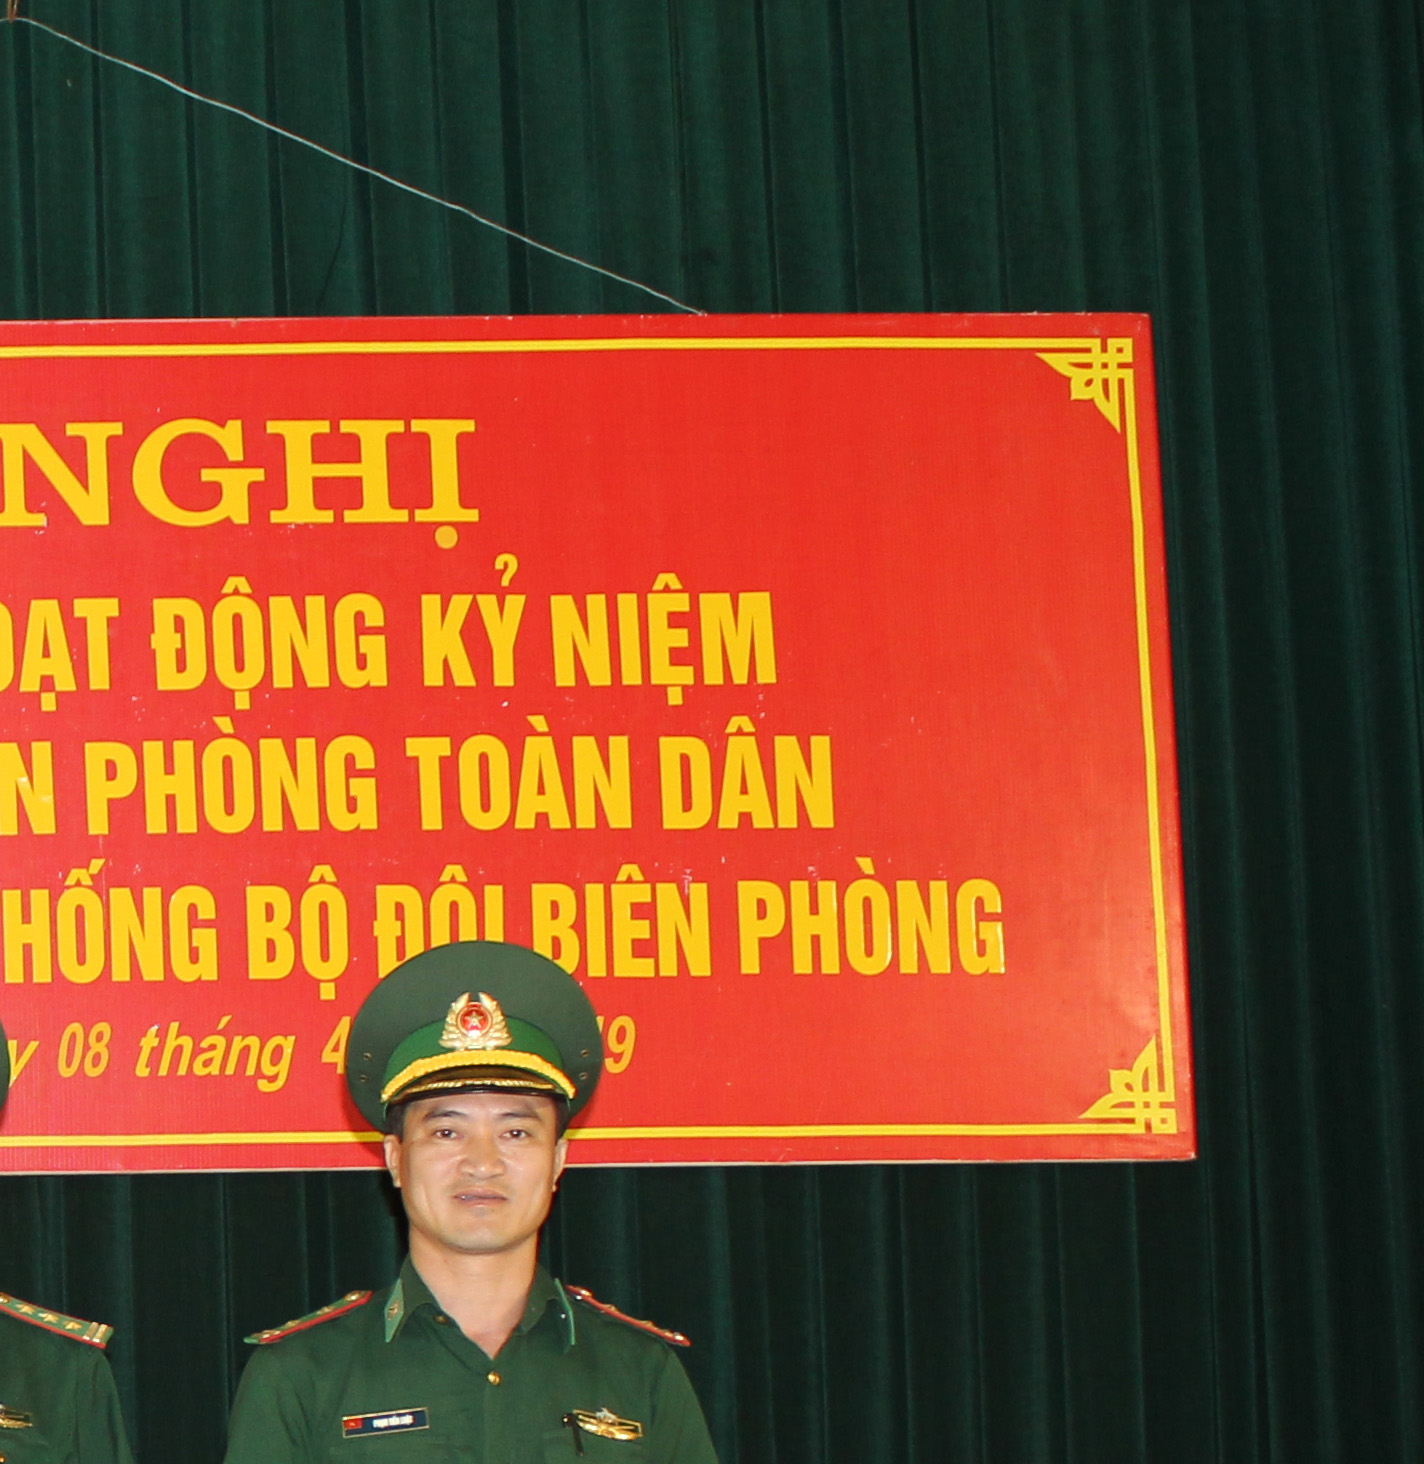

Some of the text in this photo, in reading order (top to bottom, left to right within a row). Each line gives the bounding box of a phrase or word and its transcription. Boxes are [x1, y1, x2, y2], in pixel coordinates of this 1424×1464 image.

[149, 575, 389, 711] ĐỘNG
[420, 553, 527, 687] KỶ
[549, 572, 778, 706] NIỆM
[83, 715, 379, 836] PHÒNG
[404, 714, 633, 831] TOÀN
[658, 715, 835, 830] DÂN
[245, 864, 350, 1001] BỘ
[530, 863, 712, 979] BIÊN
[736, 856, 1007, 976] PHÒNG
[56, 1021, 112, 1078] 08
[134, 1014, 298, 1093] tháng
